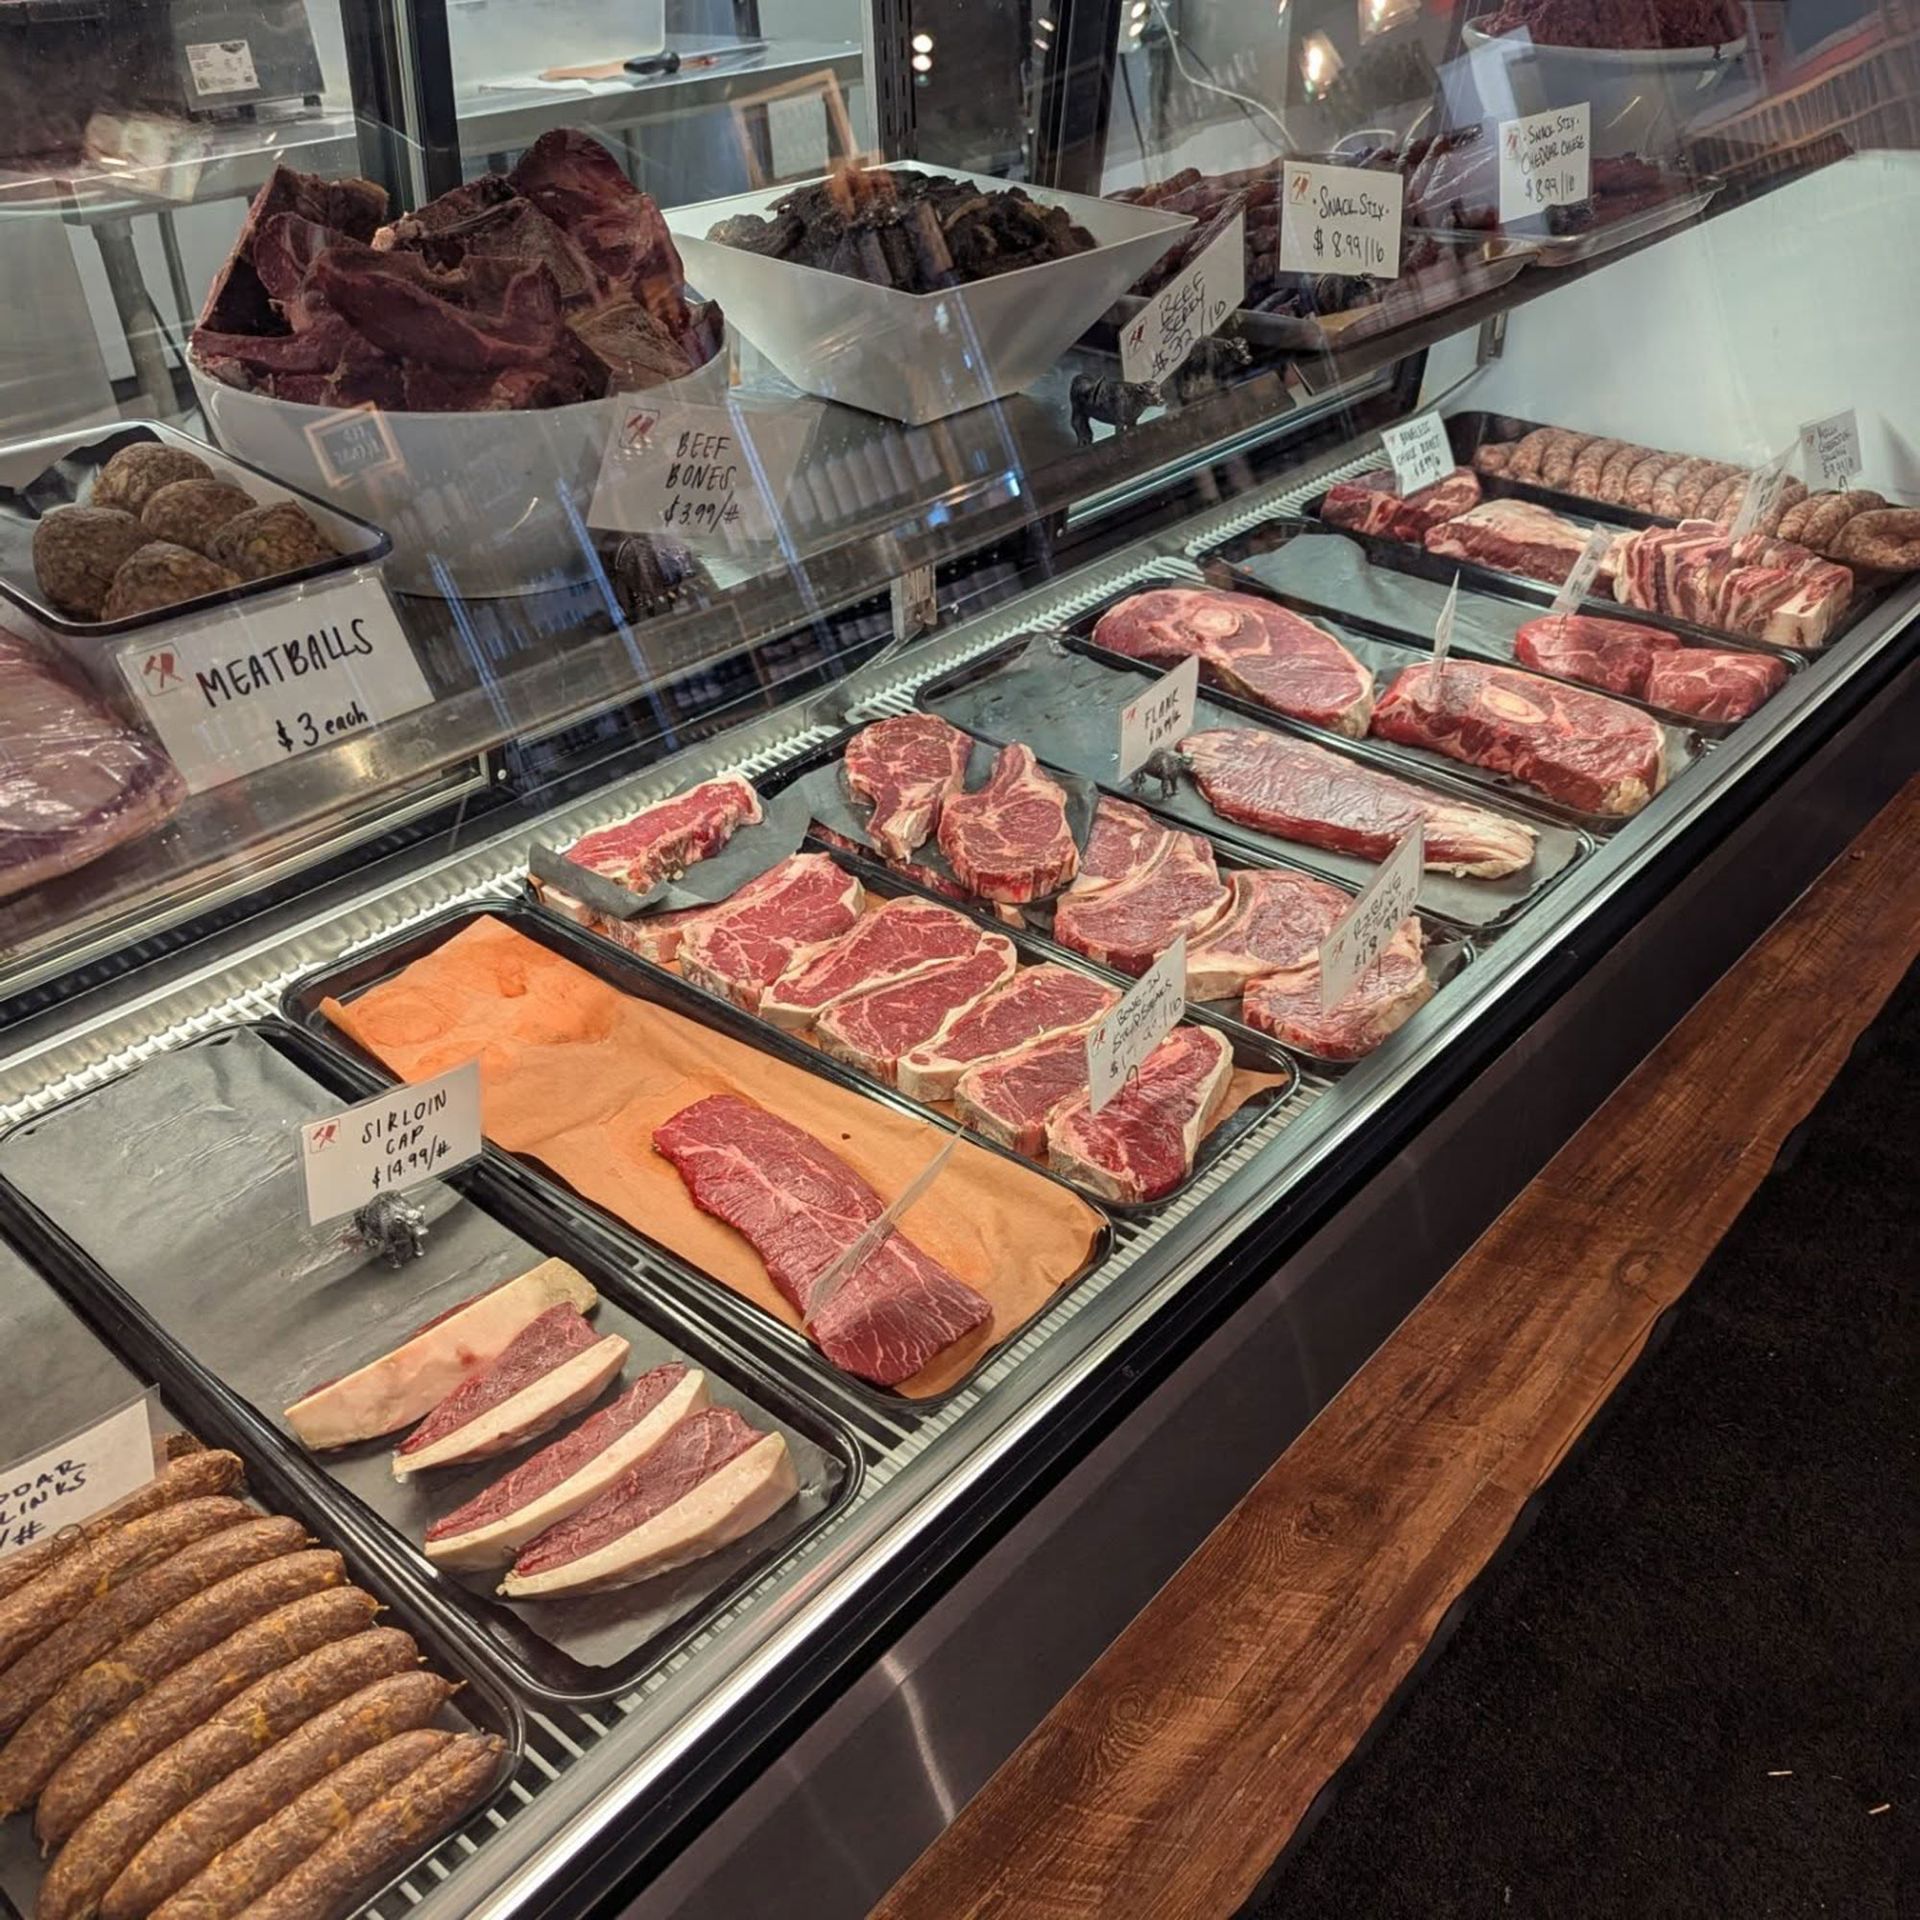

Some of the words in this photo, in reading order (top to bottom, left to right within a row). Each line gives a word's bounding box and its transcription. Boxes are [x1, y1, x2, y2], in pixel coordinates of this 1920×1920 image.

[1159, 271, 1205, 328] BEEF
[675, 430, 731, 460] BEEF
[665, 463, 737, 491] BONES
[195, 618, 373, 708] MEATBALLS
[324, 701, 368, 735] each
[1144, 686, 1179, 730] FLANK
[361, 1089, 447, 1145] SIRLOIN
[385, 1124, 425, 1155] CAP
